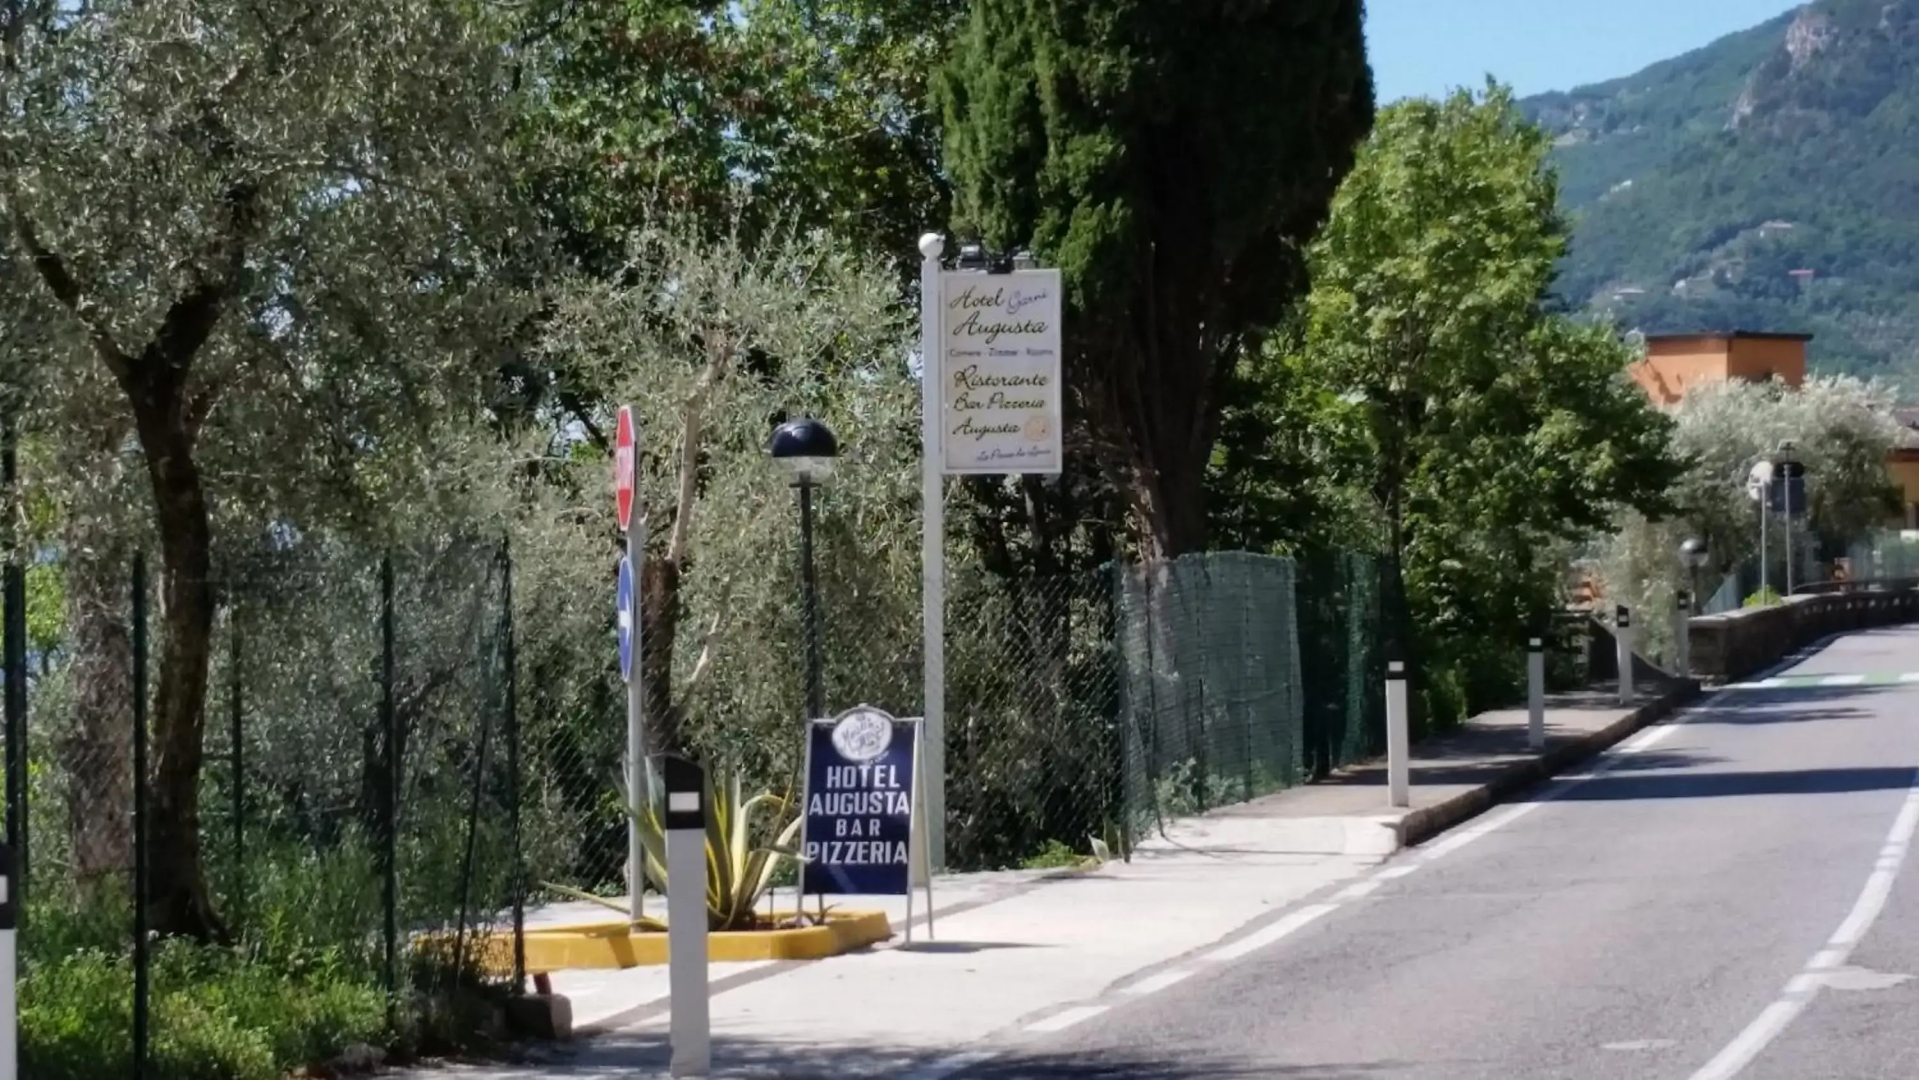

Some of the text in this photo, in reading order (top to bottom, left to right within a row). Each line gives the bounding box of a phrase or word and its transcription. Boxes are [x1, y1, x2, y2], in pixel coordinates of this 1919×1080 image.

[949, 285, 1005, 309] Hotel
[952, 310, 1049, 345] Augusta
[953, 364, 1049, 391] Ristorante
[953, 392, 984, 412] Bar
[952, 416, 1021, 442] Augusta
[826, 764, 901, 789] HOTEL
[808, 791, 910, 816] AUGUSTA
[835, 818, 881, 837] BAR
[804, 840, 908, 865] PIZZERIA
